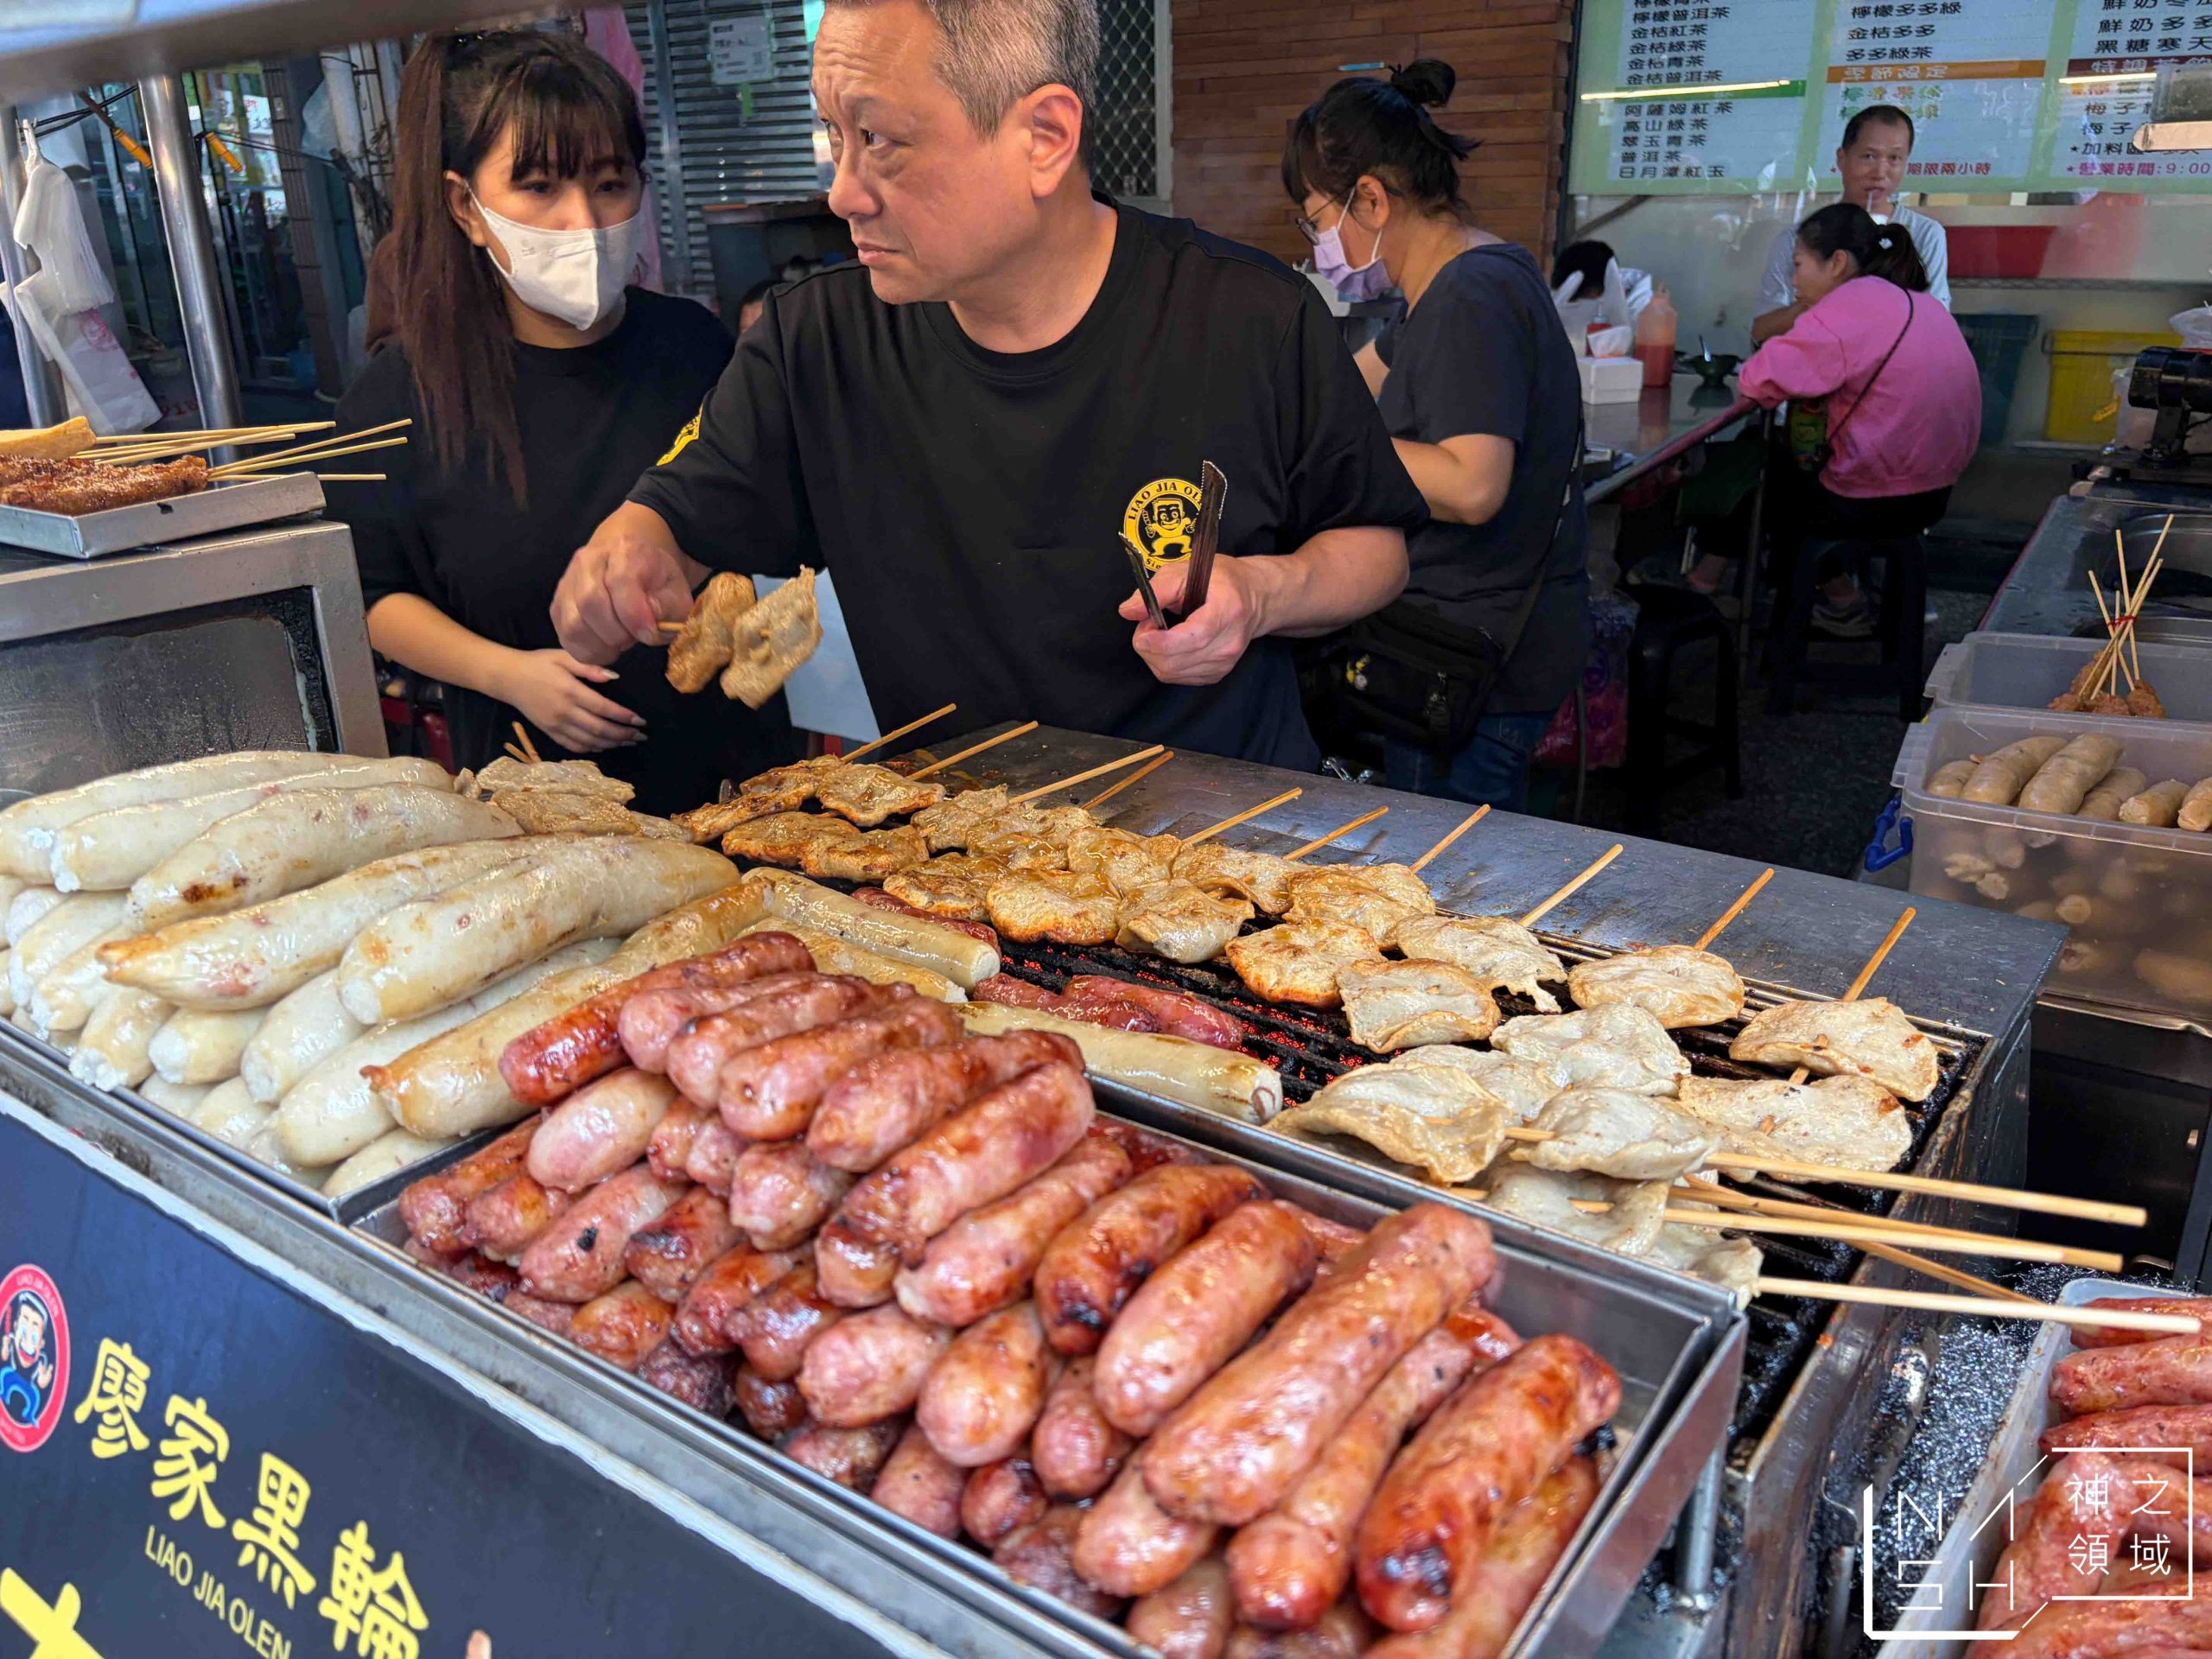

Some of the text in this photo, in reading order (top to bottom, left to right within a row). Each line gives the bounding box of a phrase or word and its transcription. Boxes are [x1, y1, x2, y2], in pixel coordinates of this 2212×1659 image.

[1633, 7, 1730, 23] 檸檬普洱茶
[1631, 24, 1708, 39] 金桔紅茶
[1848, 24, 1936, 40] 金桔多多
[2097, 16, 2212, 33] 鮮奶多多
[1630, 40, 1707, 54] 金桔綠茶
[2094, 36, 2212, 54] 黑糖寒天
[1846, 47, 1933, 61] 多多綠茶
[1628, 55, 1705, 70] 金桔青茶
[1627, 70, 1724, 85] 金桔普洱茶
[1625, 102, 1733, 117] 阿薩姆紅茶
[1624, 118, 1708, 132] 高山綠茶
[1621, 151, 1681, 163] 普洱茶
[1619, 165, 1726, 179] 日月潭紅玉
[1128, 491, 1151, 520] LIAO
[1157, 482, 1178, 493] JIA
[75, 1338, 429, 1659] 廖家黑輪
[145, 1524, 292, 1659] LIAO JIA OLEN
